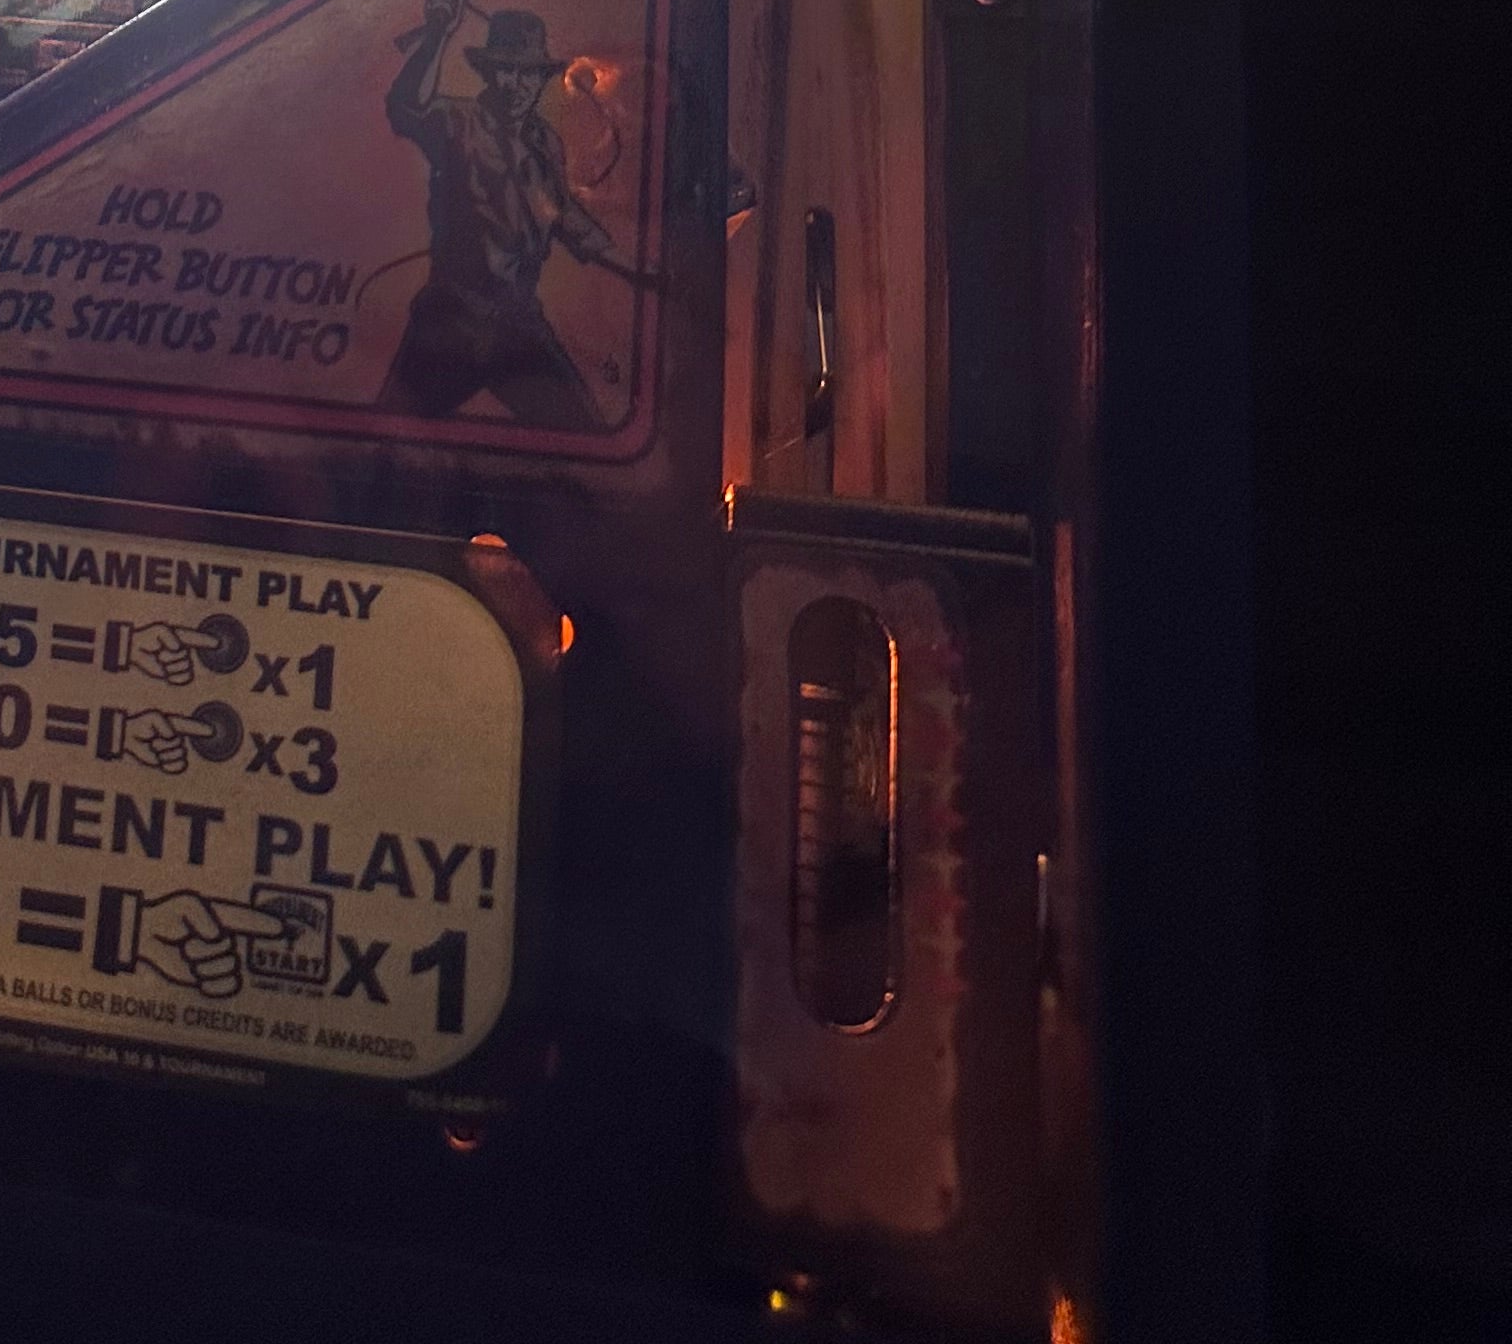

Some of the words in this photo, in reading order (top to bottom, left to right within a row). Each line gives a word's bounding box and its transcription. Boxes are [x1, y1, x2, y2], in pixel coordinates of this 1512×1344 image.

[99, 184, 223, 234] HOLD
[175, 248, 356, 306] BUTTON
[67, 295, 220, 353] STATUS
[229, 315, 349, 366] INFO
[257, 570, 382, 620] PLAY
[255, 813, 496, 910] PLAY!
[253, 947, 324, 976] START
[12, 979, 72, 1009] BALLS
[78, 989, 105, 1009] OR
[110, 995, 175, 1025] BONUS
[184, 1006, 265, 1038] CREDITS
[269, 1021, 309, 1044] ARE
[314, 1029, 418, 1062] AWARDED
